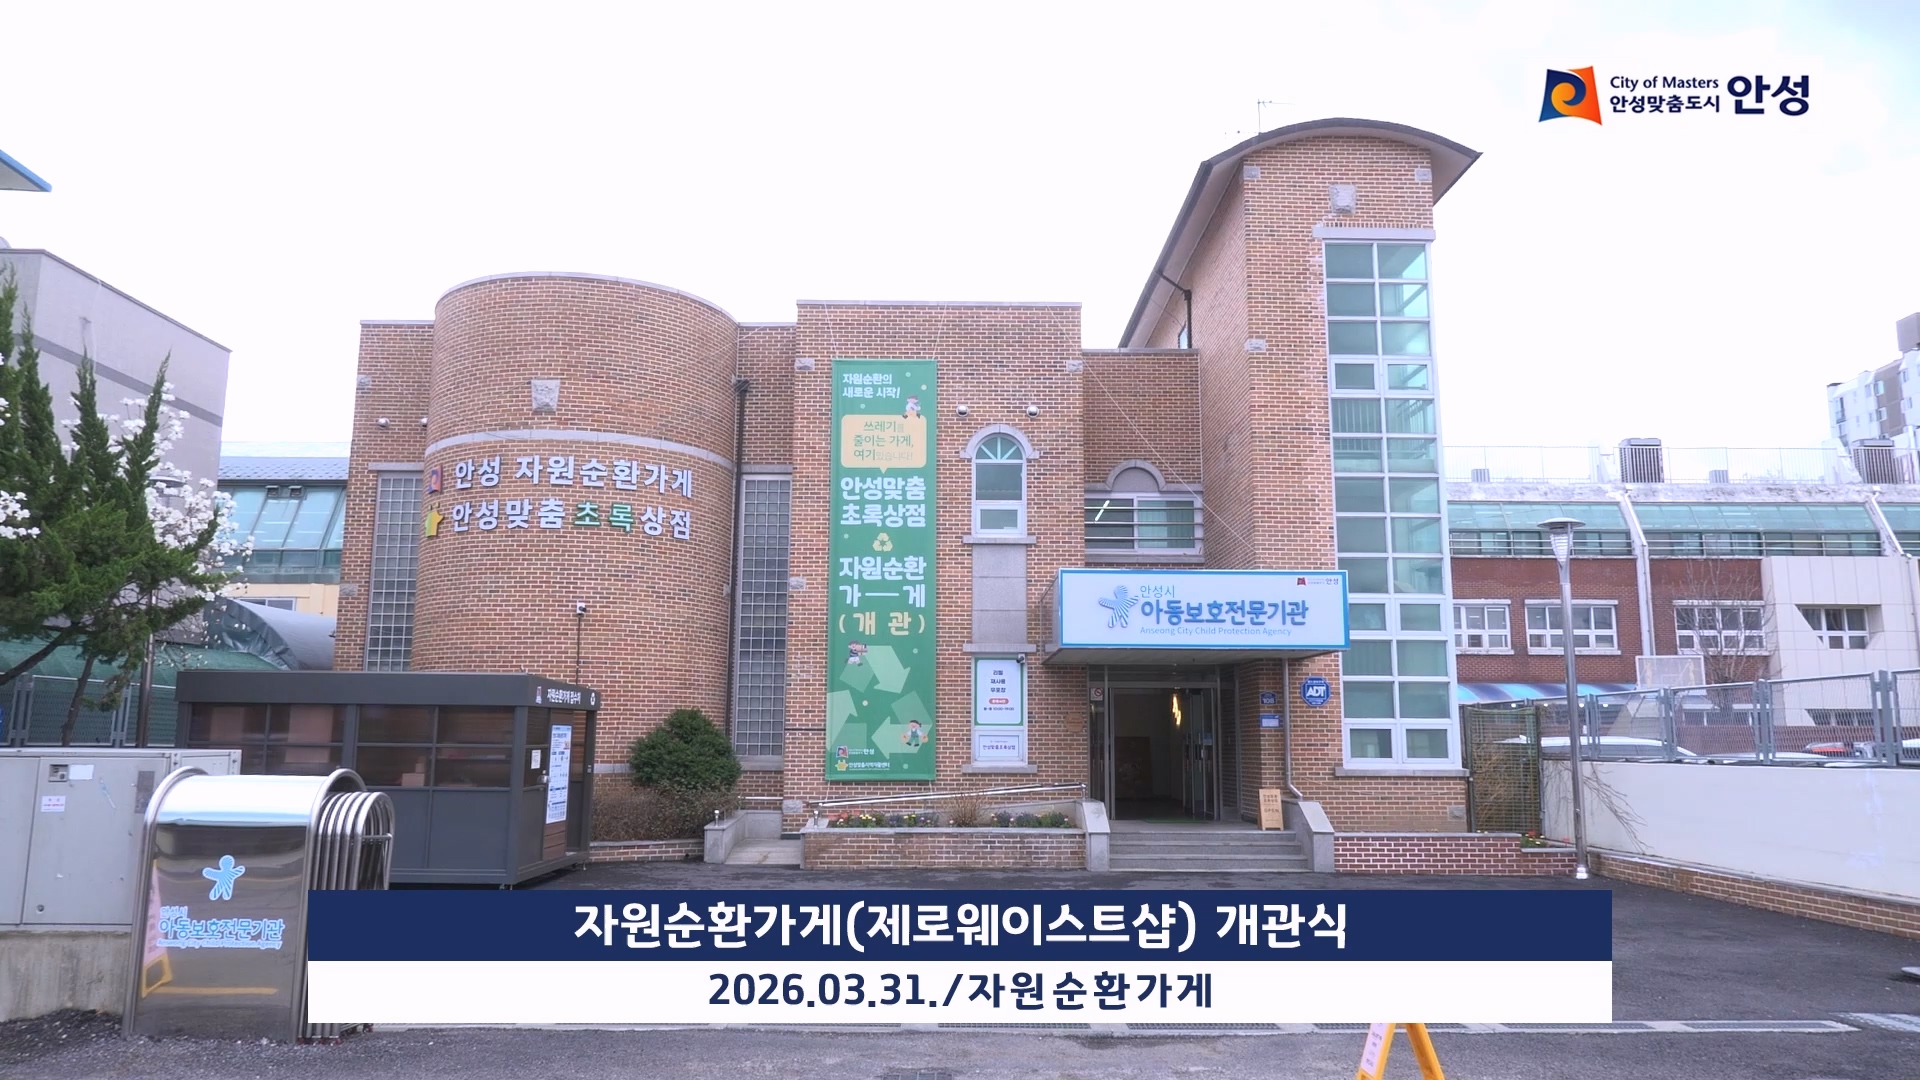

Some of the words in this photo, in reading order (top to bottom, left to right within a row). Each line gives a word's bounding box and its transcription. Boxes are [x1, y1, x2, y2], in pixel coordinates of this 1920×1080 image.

[842, 373, 892, 385] 자원순환의
[842, 387, 874, 398] 새로운
[876, 387, 900, 398] 시작!
[854, 435, 886, 447] 줄이는
[889, 435, 914, 448] 가게,
[455, 457, 501, 489] 안성
[515, 455, 692, 498] 자원순환가게
[840, 476, 926, 500] 안성맞춤
[840, 503, 926, 528] 초록상점
[839, 555, 927, 581] 자원순환
[1139, 585, 1176, 598] 안성시
[1140, 599, 1309, 627] 아동보호전문기관
[1140, 627, 1176, 636] Anseong
[1177, 626, 1193, 636] City
[1195, 626, 1216, 635] Child
[1218, 626, 1261, 635] Protection
[1262, 627, 1292, 637] Agency
[1306, 686, 1326, 697] ADT
[158, 918, 285, 940] 아동보호전문기관
